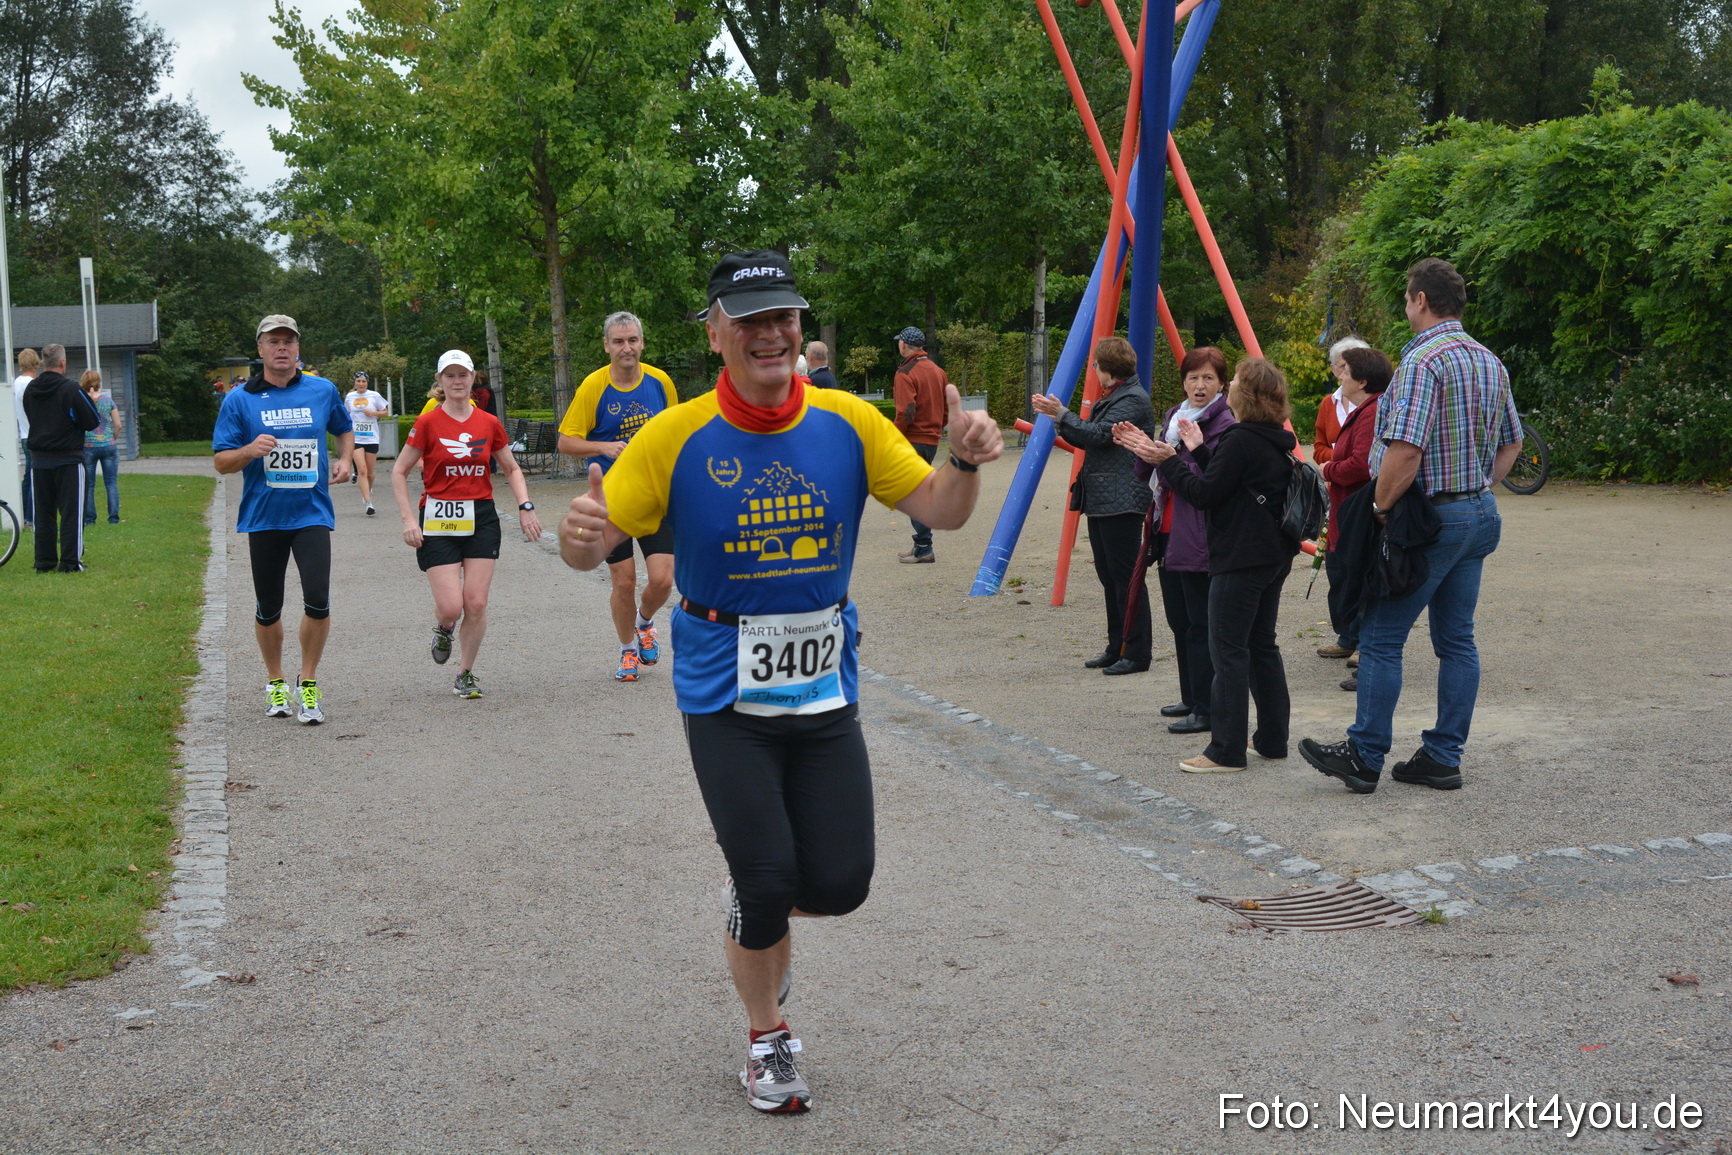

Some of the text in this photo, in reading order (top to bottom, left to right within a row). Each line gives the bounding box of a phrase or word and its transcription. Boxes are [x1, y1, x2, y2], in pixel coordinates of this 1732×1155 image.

[732, 266, 776, 281] CRAFT
[261, 408, 312, 420] HUBER
[355, 423, 372, 431] 2091
[269, 451, 313, 470] 2851
[275, 473, 308, 482] Christian
[446, 465, 485, 476] RWB
[435, 502, 465, 518] 205
[440, 522, 458, 531] Patty
[803, 523, 824, 531] 2014
[728, 564, 837, 579] www.stadtlauf-neumarkt.de
[741, 620, 830, 636] PARTL Neumarkt
[751, 633, 835, 682] 3402
[749, 687, 819, 703] Thomas
